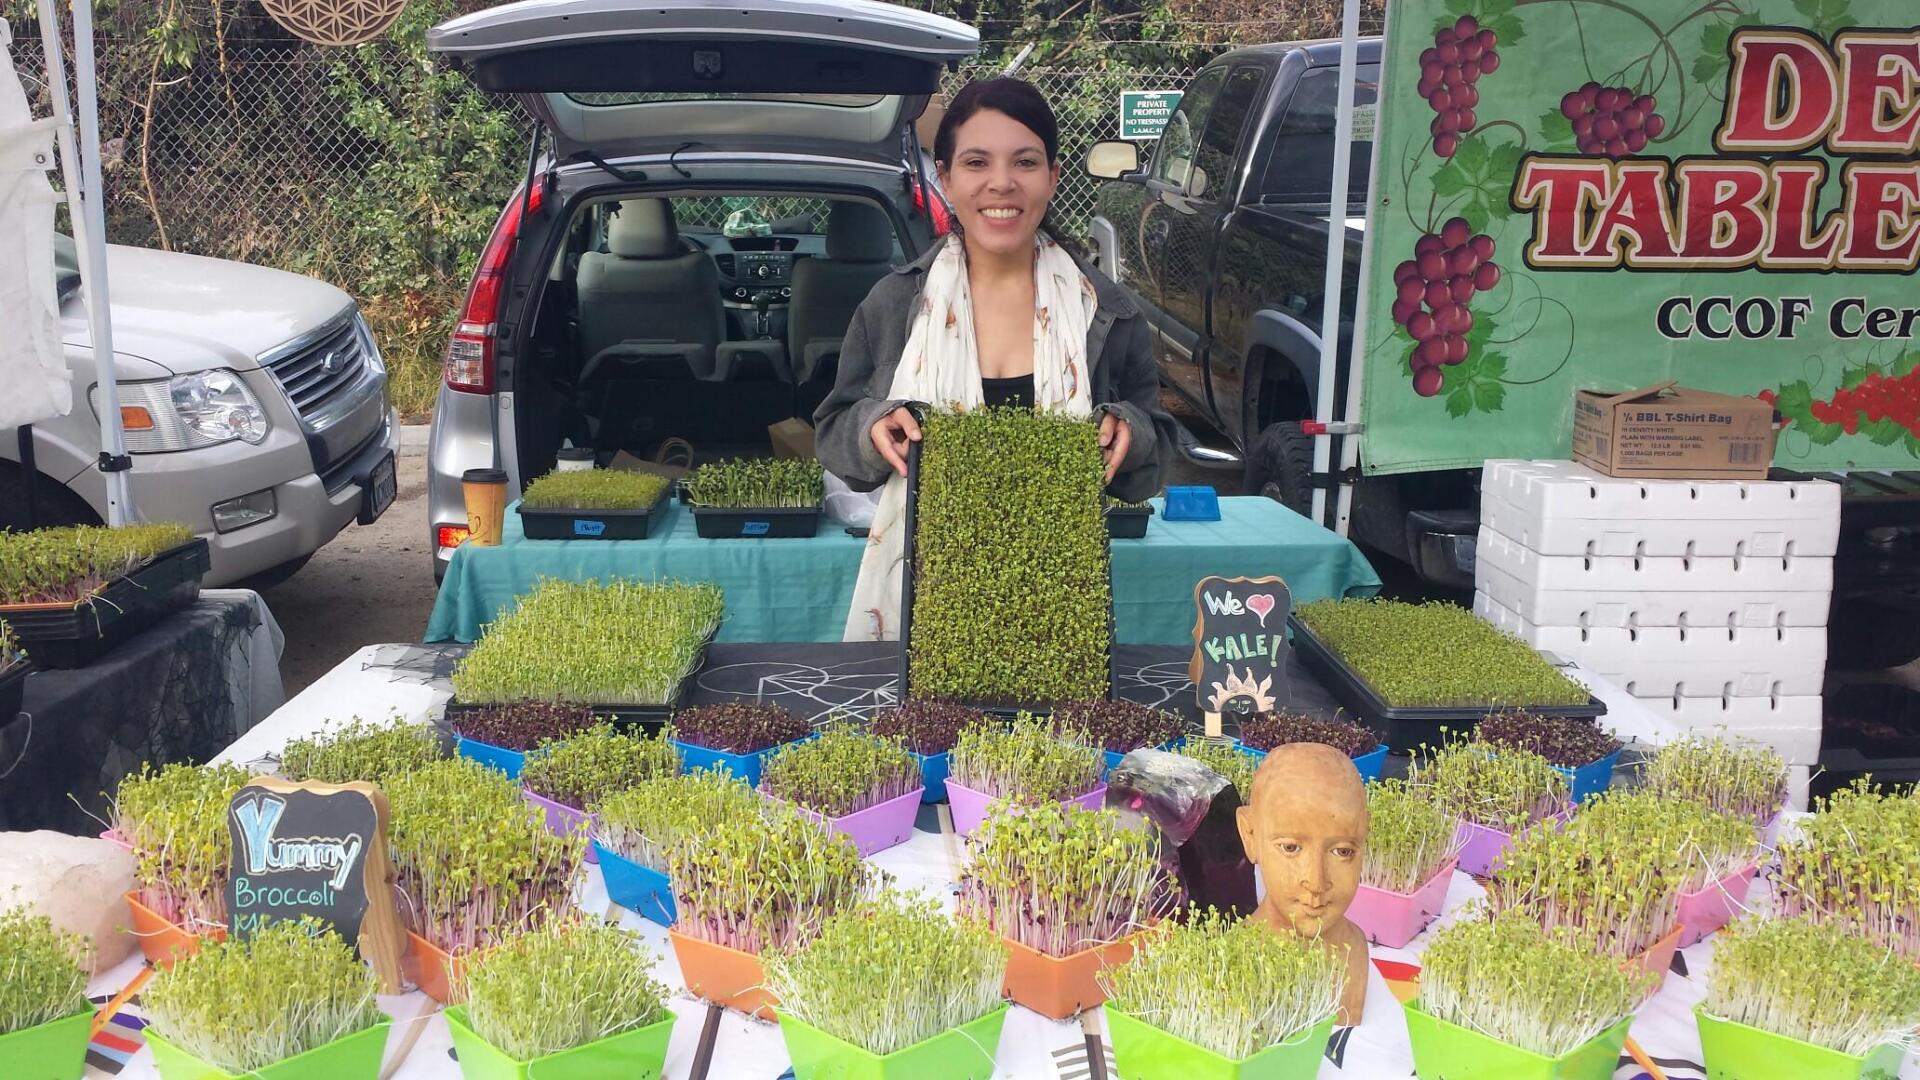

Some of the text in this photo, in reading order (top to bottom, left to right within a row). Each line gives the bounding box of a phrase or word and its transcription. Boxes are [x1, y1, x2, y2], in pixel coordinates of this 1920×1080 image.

[1714, 27, 1920, 154] DE
[1133, 108, 1171, 116] PROPERTY
[1512, 155, 1920, 271] TABLE
[1656, 296, 1920, 340] CCOF Cer
[1636, 412, 1662, 422] BBL
[1665, 412, 1705, 423] T-Shirt
[1708, 413, 1733, 425] Bag
[1203, 590, 1246, 616] We
[1203, 633, 1282, 668] KALE!
[233, 794, 360, 890] Yummy
[235, 877, 336, 908] Broccoli
